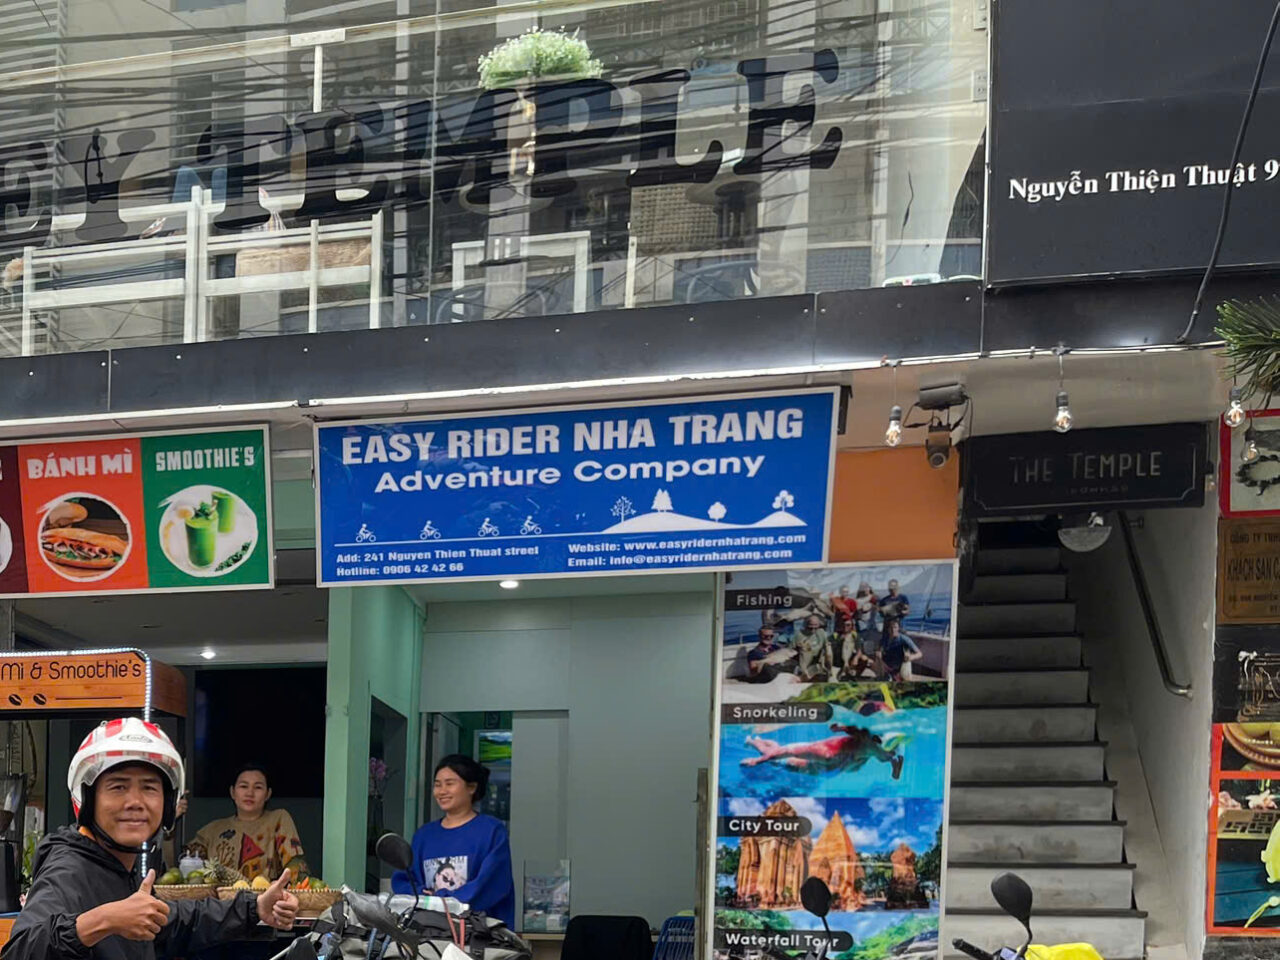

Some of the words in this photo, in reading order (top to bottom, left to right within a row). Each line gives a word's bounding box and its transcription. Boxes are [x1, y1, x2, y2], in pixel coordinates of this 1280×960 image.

[197, 48, 842, 229] TEMPLE
[1008, 170, 1099, 203] Nguyễn
[1105, 169, 1176, 194] Thiện
[1183, 162, 1257, 188] Thuật
[1264, 159, 1280, 181] 9
[342, 431, 436, 466] EASY
[448, 423, 561, 459] RIDER
[573, 418, 656, 452] NHA
[668, 408, 804, 446] TRANG
[26, 452, 99, 480] BÁNH
[101, 447, 133, 476] MÌ
[155, 446, 256, 472] SMOOTHIE'S
[1009, 455, 1054, 484] THE
[1066, 451, 1163, 479] TEMPLE
[374, 463, 561, 493] Adventure
[573, 452, 766, 484] Company
[568, 541, 620, 554] Website:
[623, 534, 807, 552] www.easyridernhatrang.com
[336, 553, 361, 564] Add:
[363, 552, 385, 562] 241
[388, 551, 432, 563] Nguyen
[434, 549, 466, 559] Thien
[469, 547, 502, 558] Thuat
[504, 545, 539, 556] street
[568, 556, 607, 567] Email:
[609, 549, 793, 566] info@easyridernhatrang.com
[336, 565, 380, 577] Hotline:
[382, 565, 412, 574] 0906
[414, 564, 429, 573] 42
[432, 563, 447, 572] 42
[736, 594, 793, 608] Fishing
[49, 659, 142, 680] Smoothie's
[733, 706, 818, 720] Snorkeling
[729, 820, 761, 834] City
[765, 820, 800, 831] Tour
[725, 932, 799, 946] Waterfall
